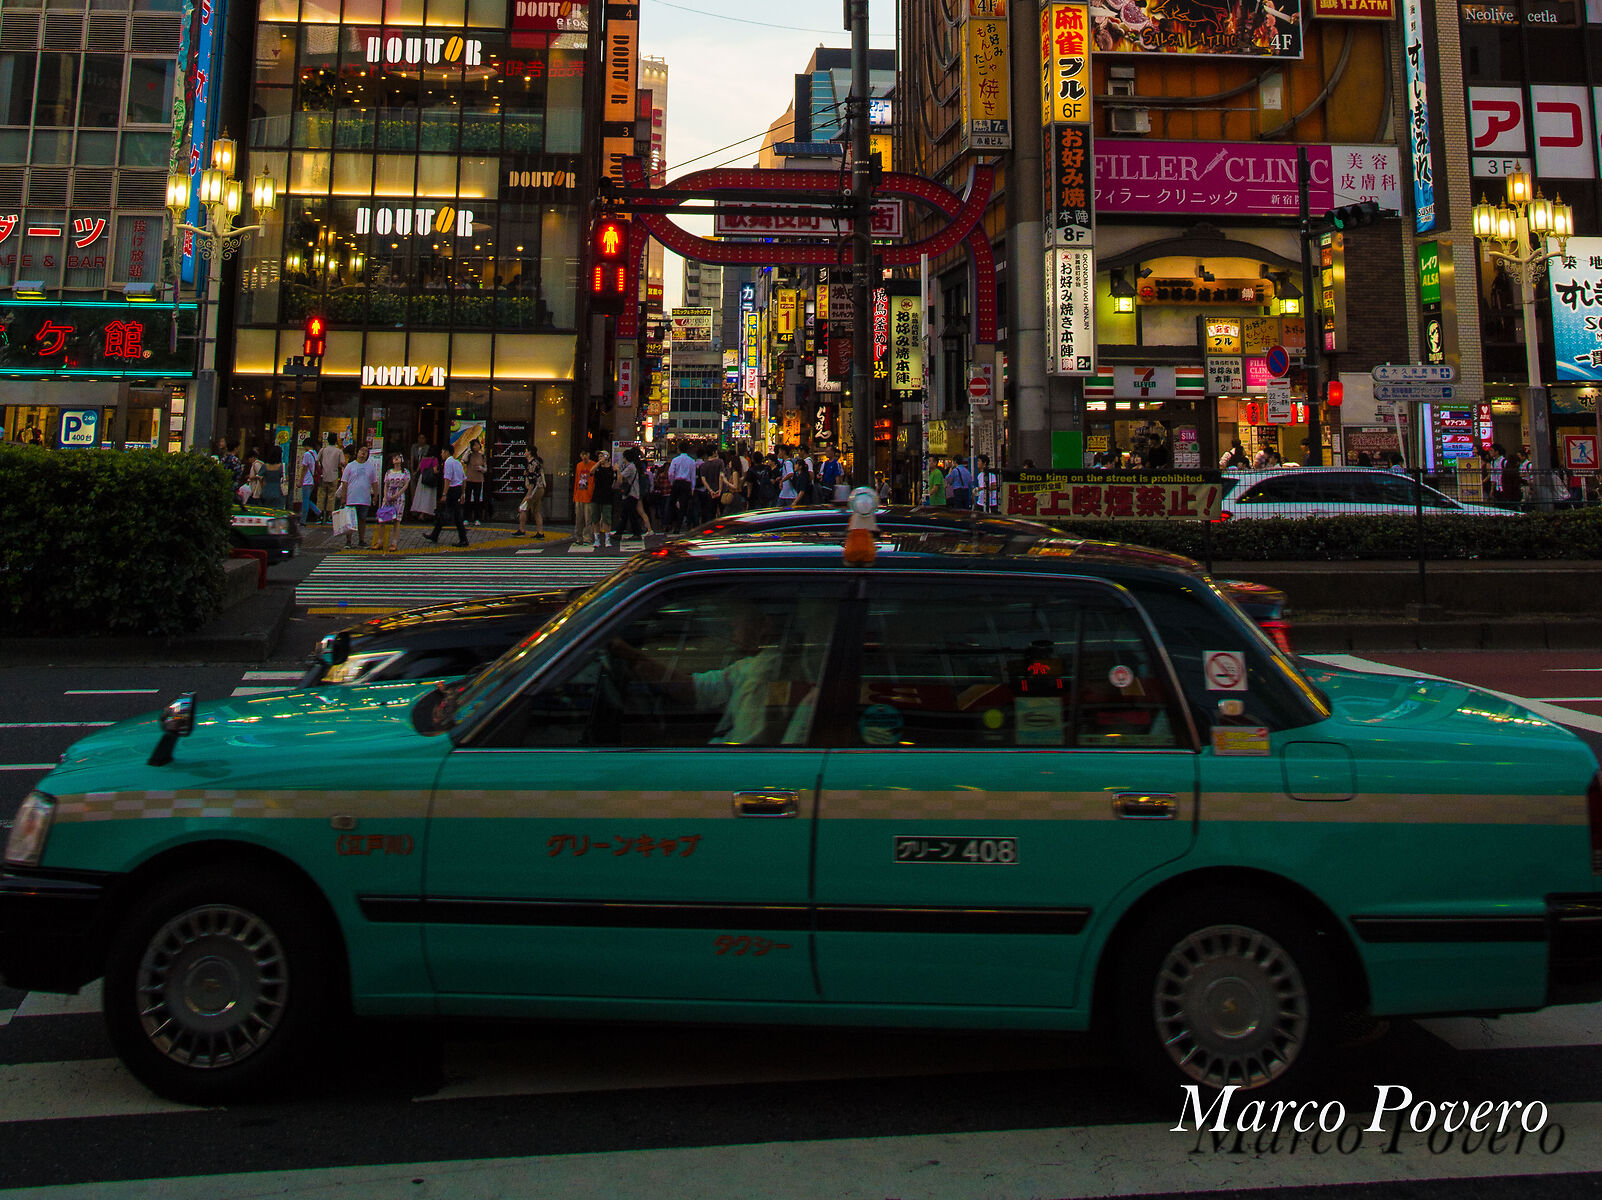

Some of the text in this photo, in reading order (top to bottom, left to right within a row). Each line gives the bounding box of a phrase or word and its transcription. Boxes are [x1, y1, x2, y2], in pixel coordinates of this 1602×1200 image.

[516, 0, 582, 18] DOUTOR
[626, 9, 632, 18] 4
[1465, 8, 1558, 23] Neolive cetla
[986, 23, 1004, 57] お好み
[1142, 28, 1237, 48] SALSA LATINO
[1270, 34, 1292, 50] 4F
[366, 36, 482, 66] DOUTOR
[976, 28, 998, 72] もんじゃ
[1054, 6, 1086, 100] 麻雀ブル
[611, 34, 630, 105] DOUTOR
[974, 53, 988, 76] たこ
[978, 78, 1000, 117] 焼き
[1062, 104, 1082, 118] 6F
[1472, 100, 1584, 148] アコ
[1061, 128, 1085, 208] お好み焼
[1094, 154, 1330, 184] FILLER CLINC
[1346, 152, 1388, 170] 美容
[1488, 159, 1513, 175] 3F
[508, 170, 576, 190] DOUTOR
[1340, 174, 1397, 192] 皮膚科
[1094, 186, 1239, 206] フィラー クリニック
[355, 206, 474, 238] DOUTOR
[1058, 210, 1089, 224] 本陣
[0, 214, 107, 248] ダーツ
[1063, 228, 1085, 242] 8F
[67, 256, 106, 269] BAR
[1422, 273, 1439, 287] ALSA
[820, 286, 828, 318] クアトロ
[1060, 262, 1074, 358] お好み焼き本陣
[782, 310, 791, 331] 1
[0, 320, 144, 358] ケ館
[780, 334, 794, 343] 4F
[896, 310, 912, 385] お好み焼本陣
[362, 364, 445, 388] DOUTOR
[900, 390, 913, 398] 2F
[63, 416, 82, 442] P
[1181, 430, 1196, 440] SIM
[1086, 474, 1104, 483] the
[1106, 474, 1137, 483] street
[1139, 474, 1148, 483] is
[1151, 473, 1205, 484] prohibited.
[546, 834, 702, 858] グリーンキャブ
[898, 840, 1017, 863] グリーン 408
[714, 934, 792, 957] タクシー
